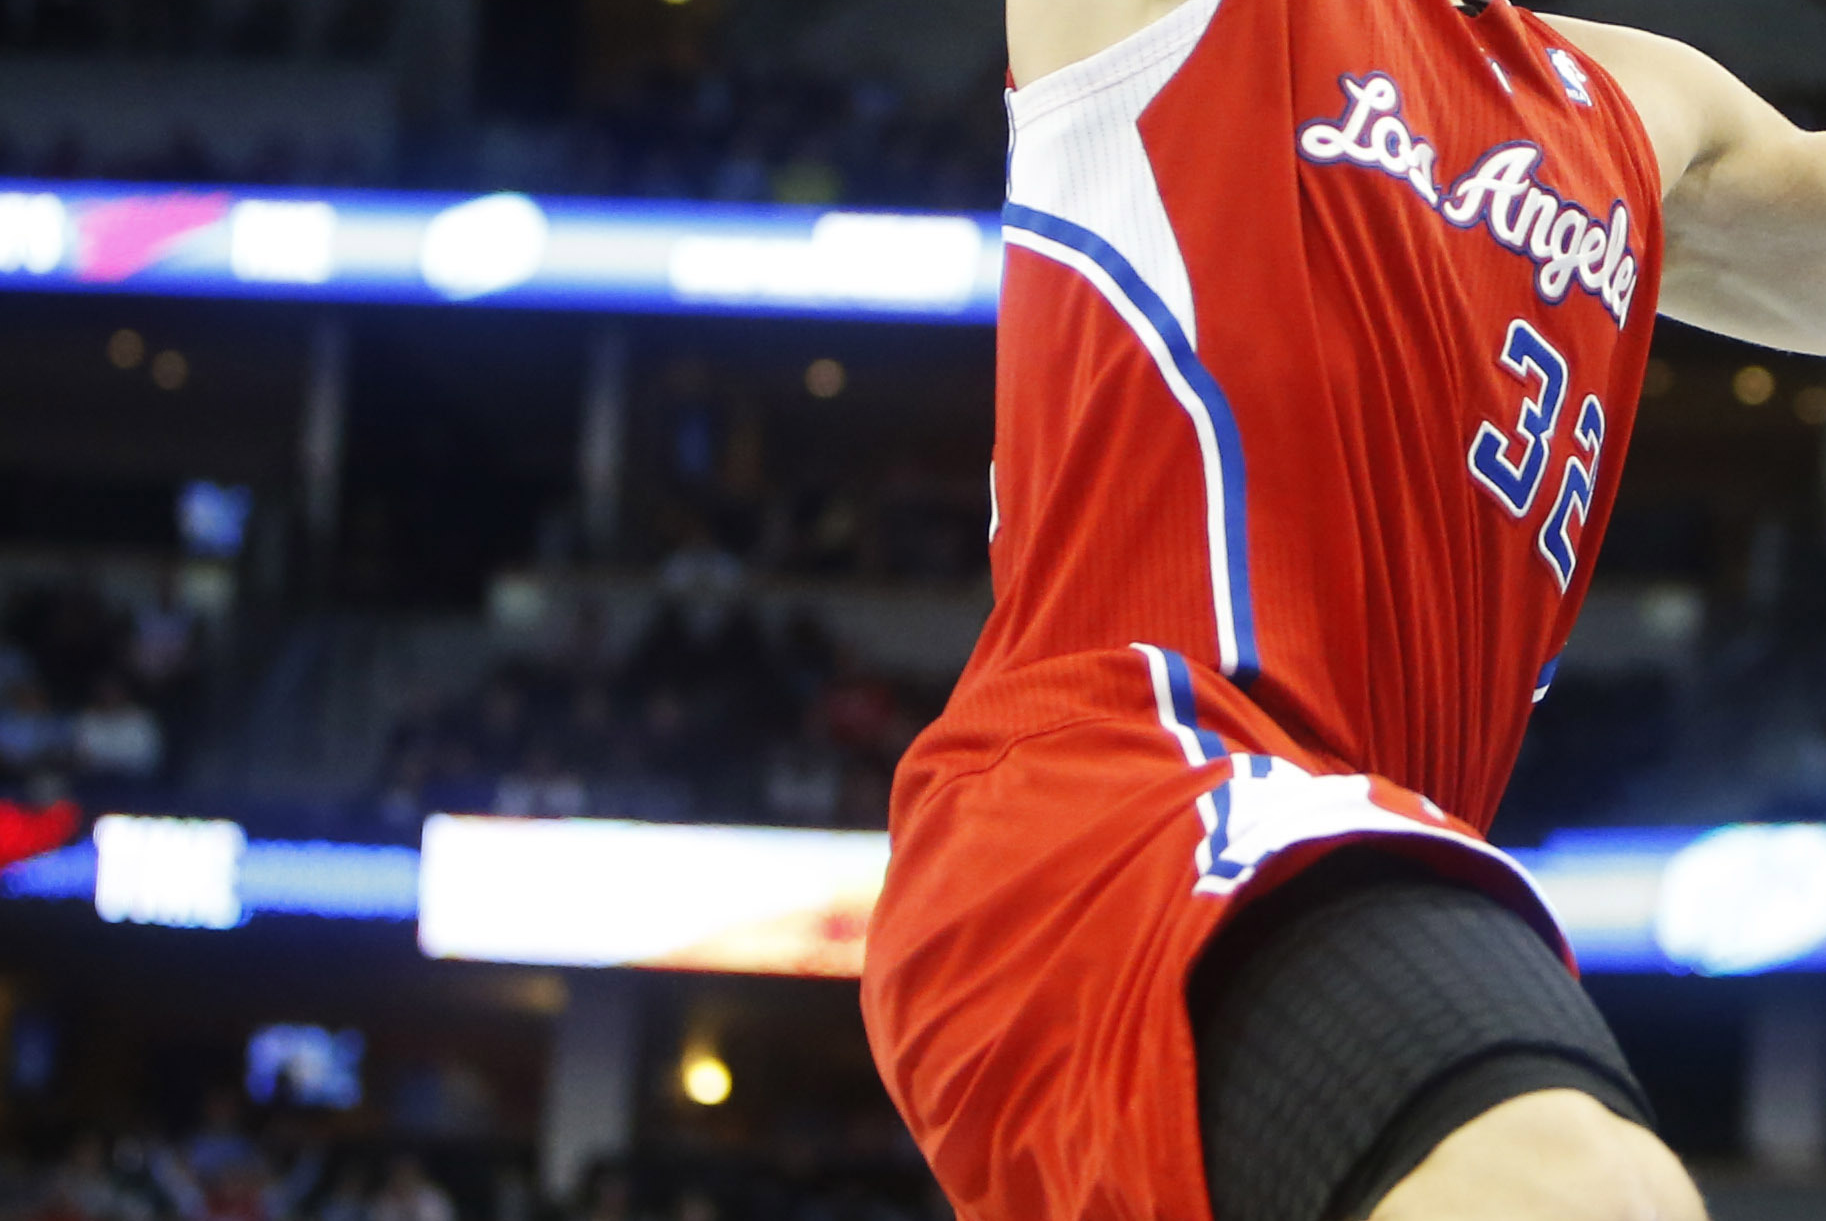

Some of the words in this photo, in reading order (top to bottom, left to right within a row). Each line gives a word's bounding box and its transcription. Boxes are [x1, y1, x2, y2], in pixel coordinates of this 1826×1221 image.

[1298, 71, 1440, 211] Los
[1441, 140, 1638, 331] Angele
[1468, 318, 1607, 596] 32
